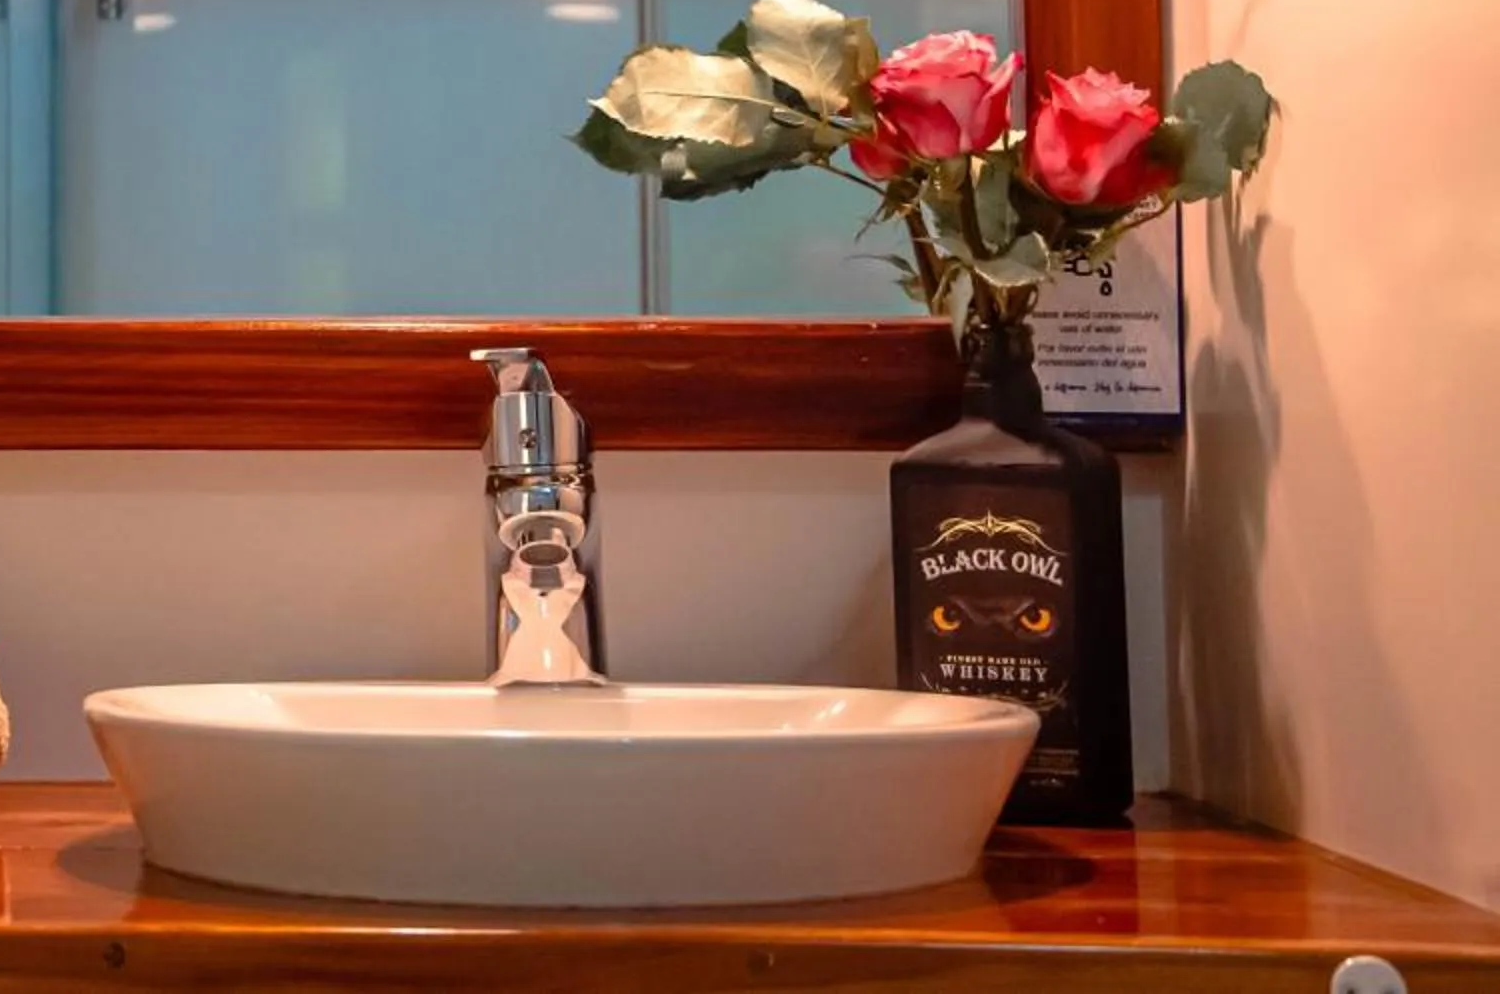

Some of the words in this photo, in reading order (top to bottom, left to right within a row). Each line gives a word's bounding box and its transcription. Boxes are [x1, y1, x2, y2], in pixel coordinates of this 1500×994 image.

[920, 549, 1008, 582] BLACK
[1011, 551, 1064, 587] OWL
[939, 663, 1049, 683] WHISKEY
